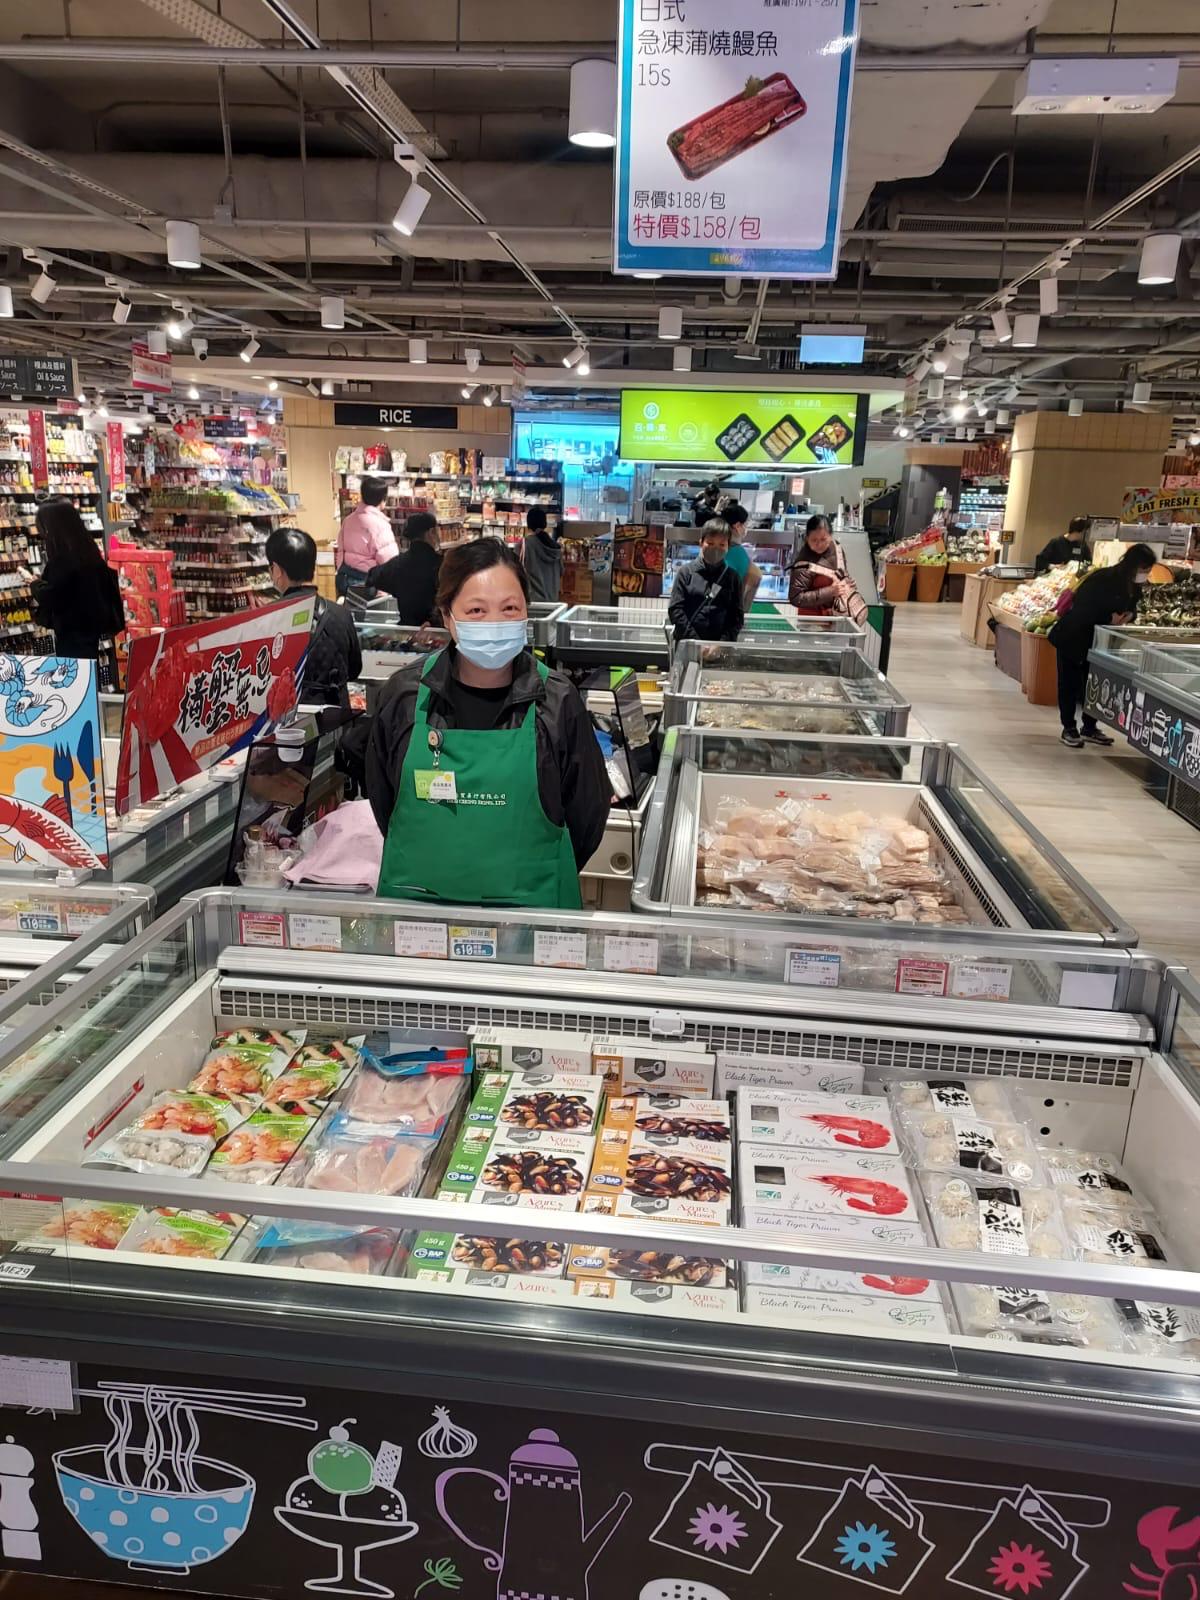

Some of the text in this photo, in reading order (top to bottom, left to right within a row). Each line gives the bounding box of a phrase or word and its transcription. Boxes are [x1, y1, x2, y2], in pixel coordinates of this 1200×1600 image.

[640, 0, 686, 23] 日式
[638, 29, 778, 57] 急凍蒲燒鰻魚
[633, 190, 726, 210] 原價$188/包
[633, 213, 761, 240] 特價$158/包
[50, 373, 65, 382] Sauce
[379, 409, 412, 423] RICE
[1137, 501, 1155, 513] EAT
[1159, 497, 1190, 508] FRESH
[549, 1055, 575, 1067] Azure
[673, 1067, 700, 1079] Azure
[725, 1071, 793, 1086] Black Tiger Prawn
[677, 1203, 710, 1213] Azure
[686, 1211, 716, 1220] Mussel
[756, 1216, 783, 1226] Black
[786, 1218, 808, 1230] Tiger
[514, 1281, 541, 1292] Azure
[682, 1291, 717, 1302] Azure
[692, 1299, 724, 1310] Mussel
[760, 1298, 854, 1314] Black Tiger Prawn
